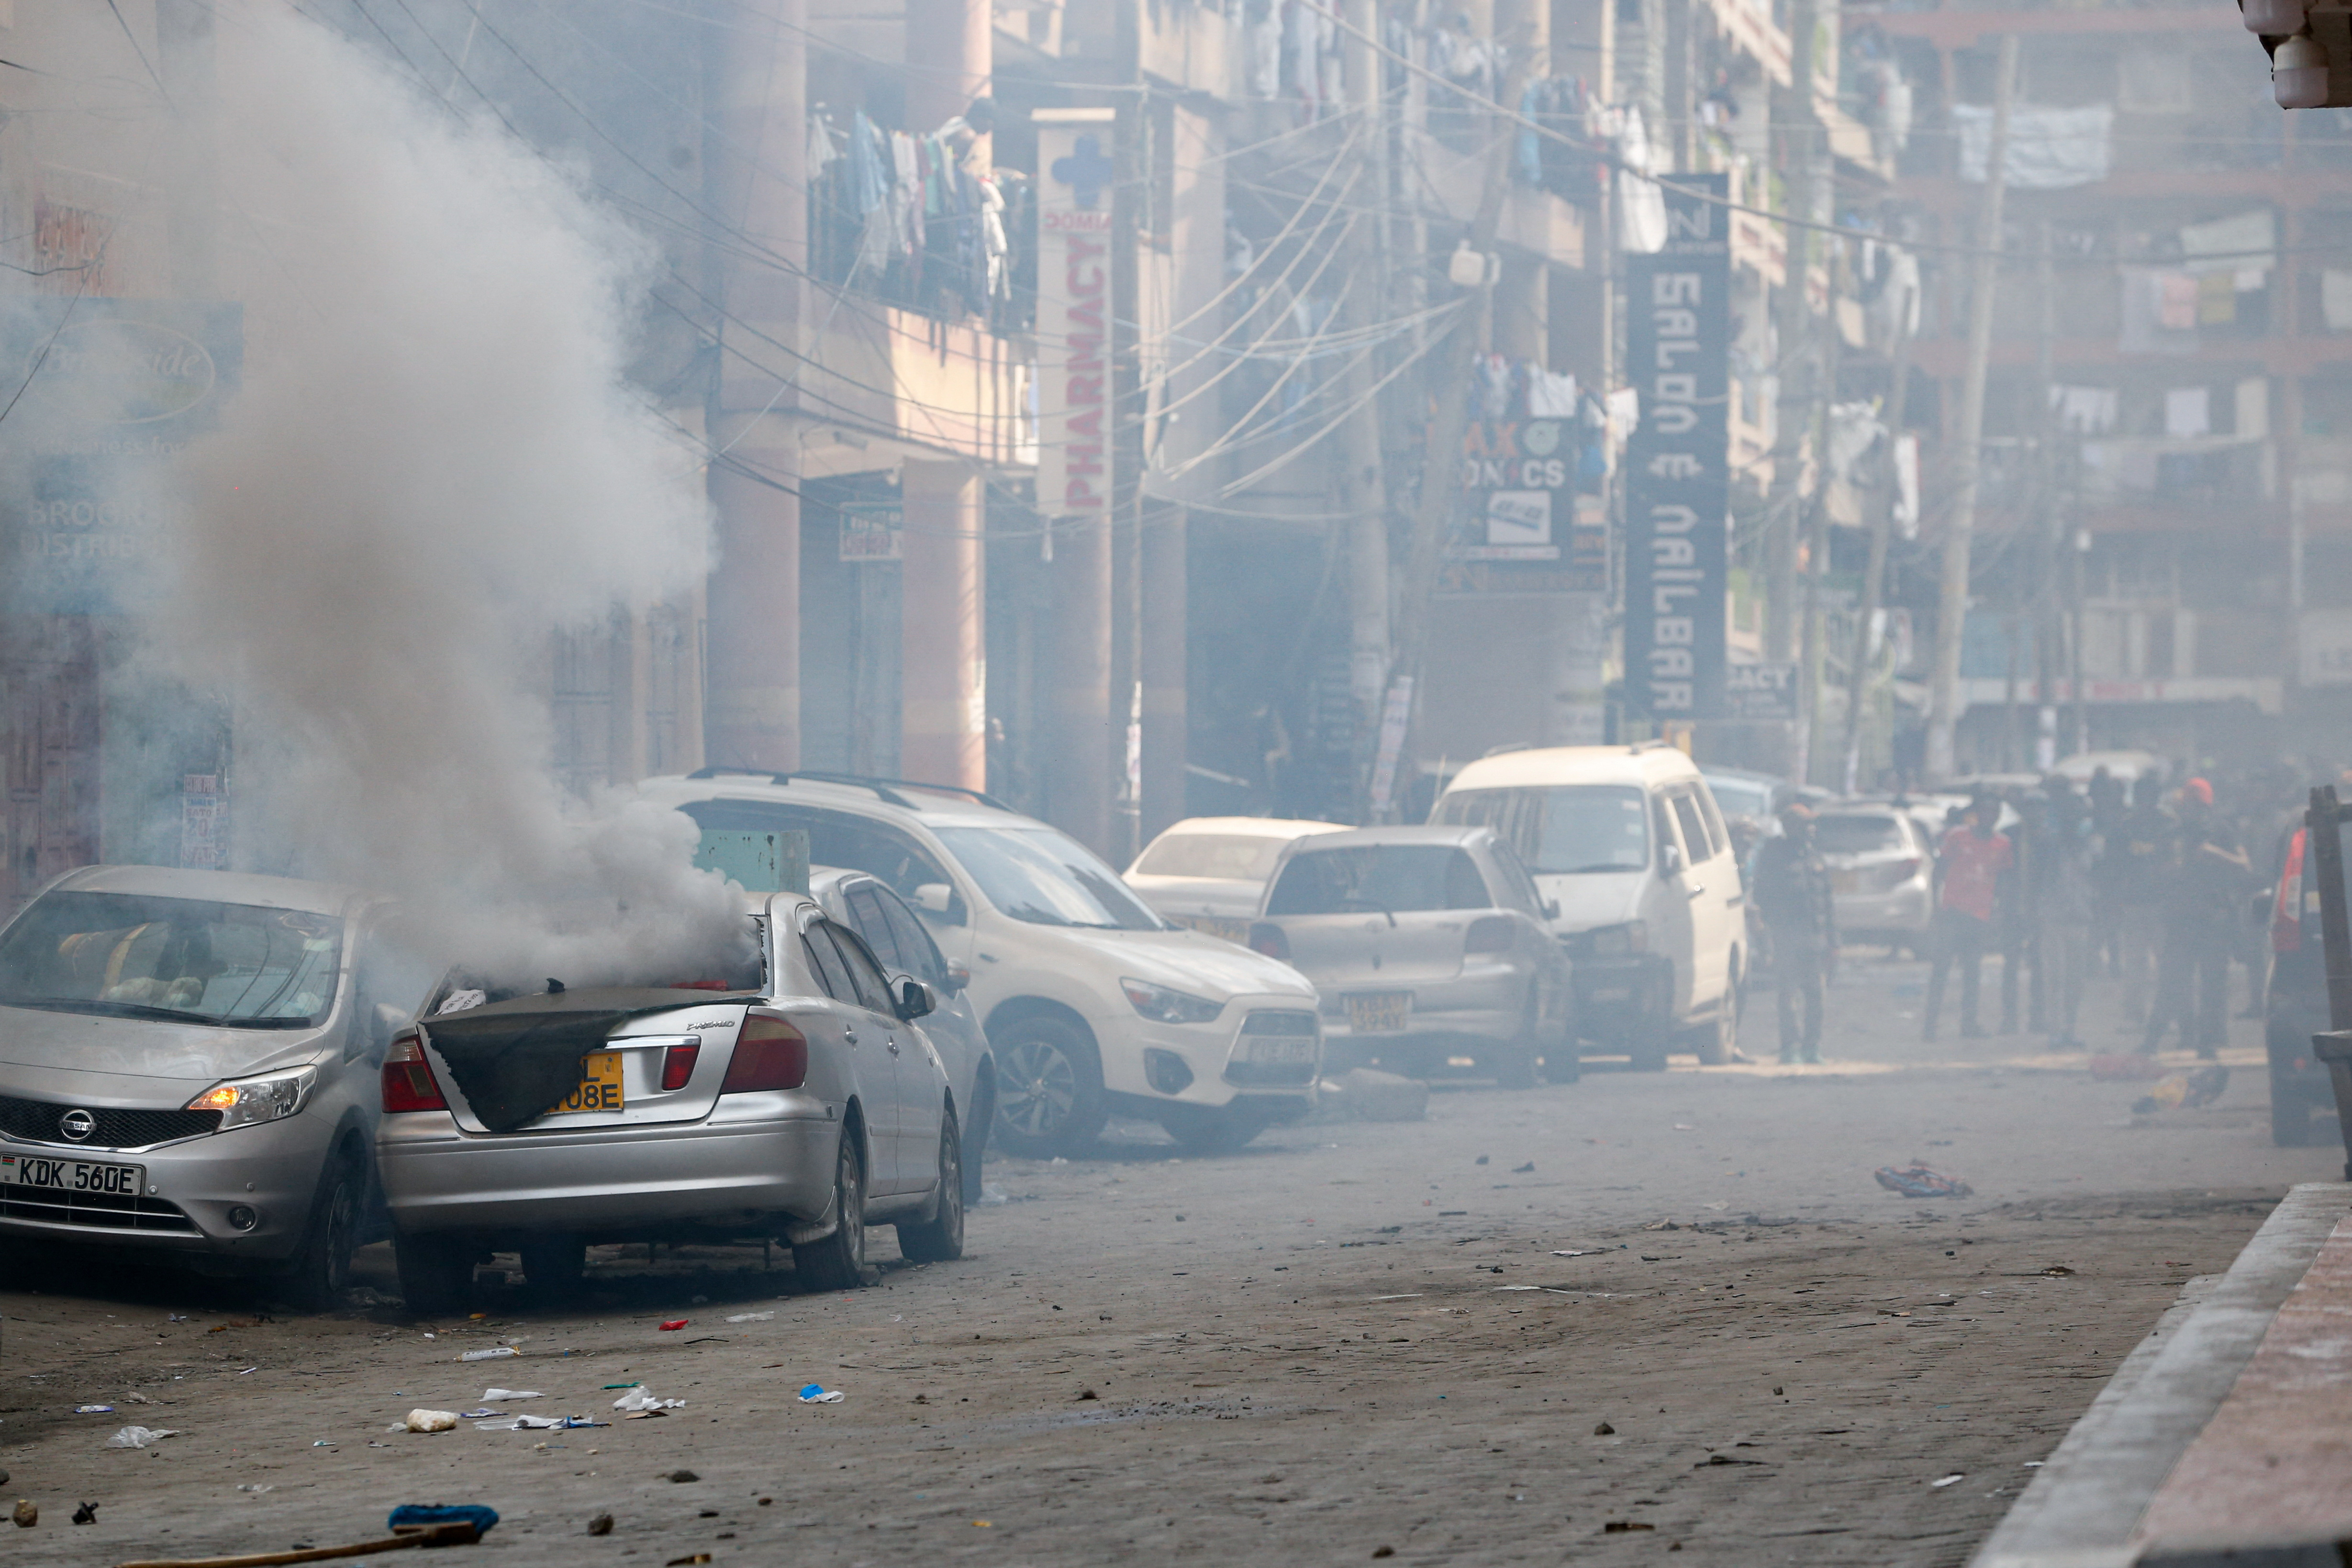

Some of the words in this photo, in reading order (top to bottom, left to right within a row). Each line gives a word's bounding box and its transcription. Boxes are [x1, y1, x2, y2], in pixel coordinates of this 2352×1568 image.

[1651, 272, 1702, 434] SALON
[1066, 235, 1105, 507] PHARMACY
[686, 1021, 735, 1031] PREMIO
[554, 1083, 619, 1111] 08E
[60, 1122, 92, 1130] NISSAN
[19, 1158, 66, 1188] KDK
[75, 1164, 134, 1194] 560E
